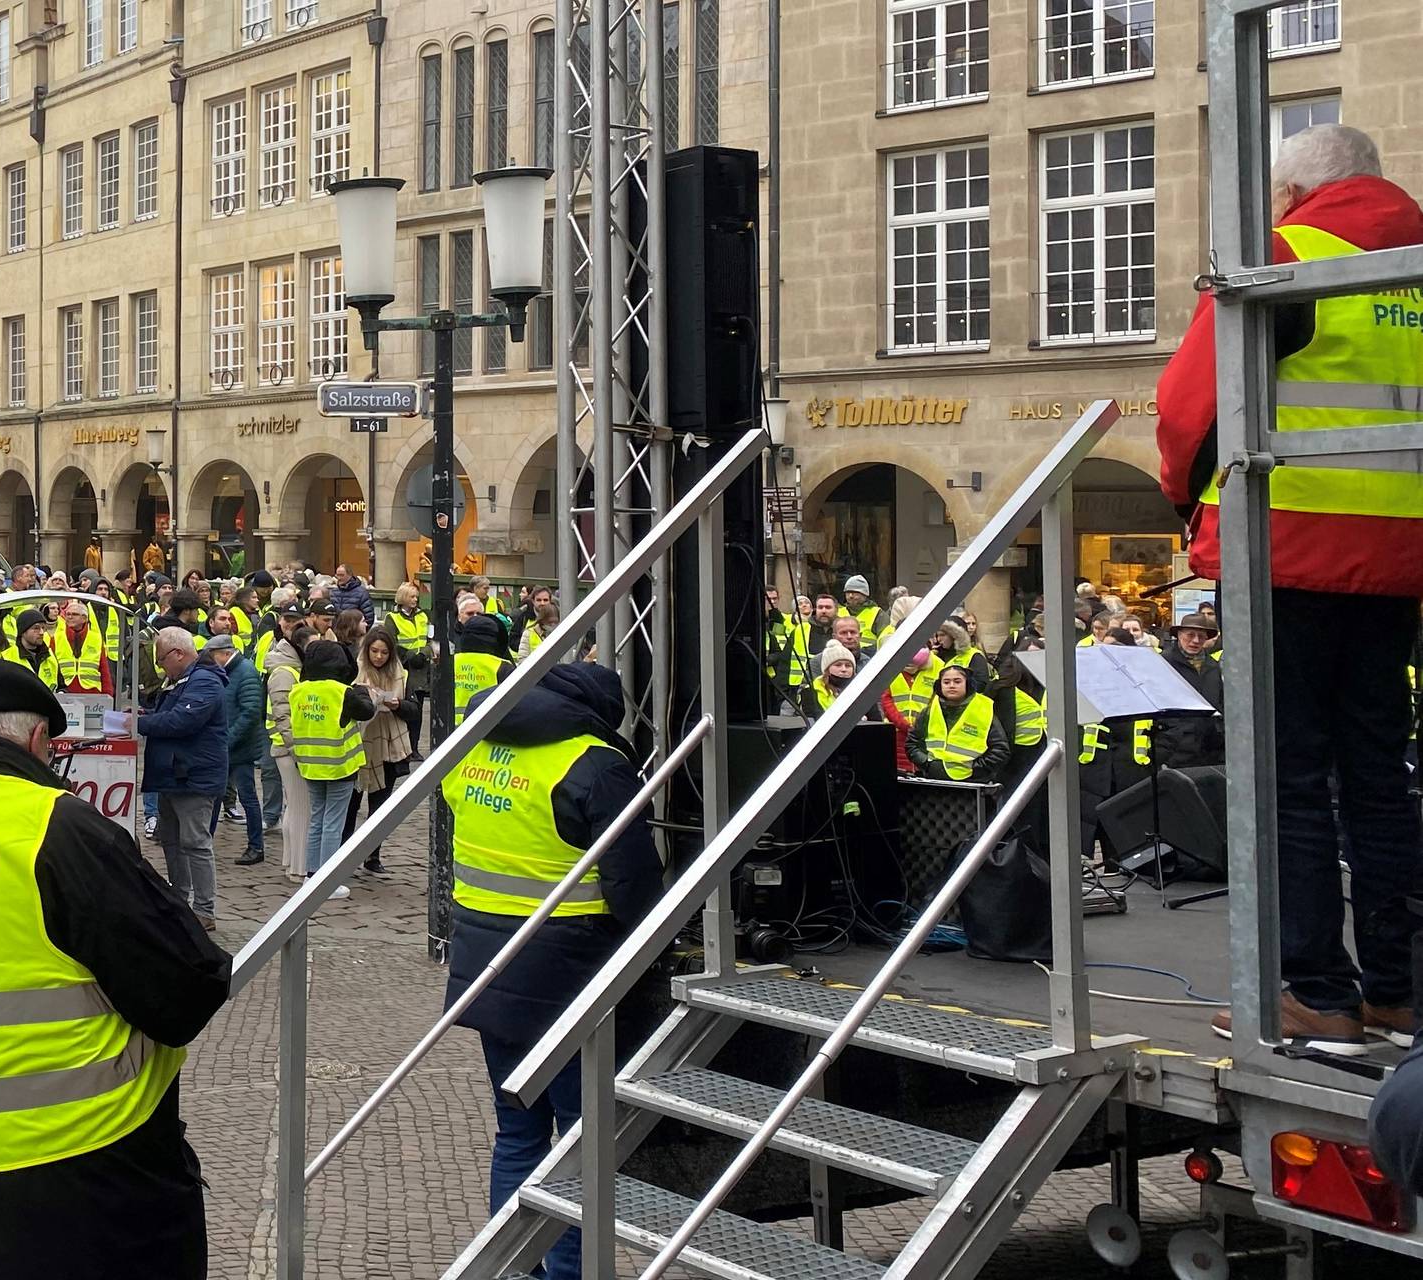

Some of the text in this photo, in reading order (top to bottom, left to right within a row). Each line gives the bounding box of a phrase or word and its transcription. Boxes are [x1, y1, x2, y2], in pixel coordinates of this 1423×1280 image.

[1373, 304, 1423, 333] Pfle
[329, 391, 411, 407] Salzstraße
[834, 396, 969, 428] Tollkötter
[1008, 402, 1062, 420] HAUS
[237, 414, 301, 437] schnitzler
[335, 499, 365, 512] schnit
[455, 672, 486, 682] önn(t)en
[489, 746, 516, 766] Wir
[461, 762, 530, 792] könn(t)en
[465, 784, 513, 813] Pflege
